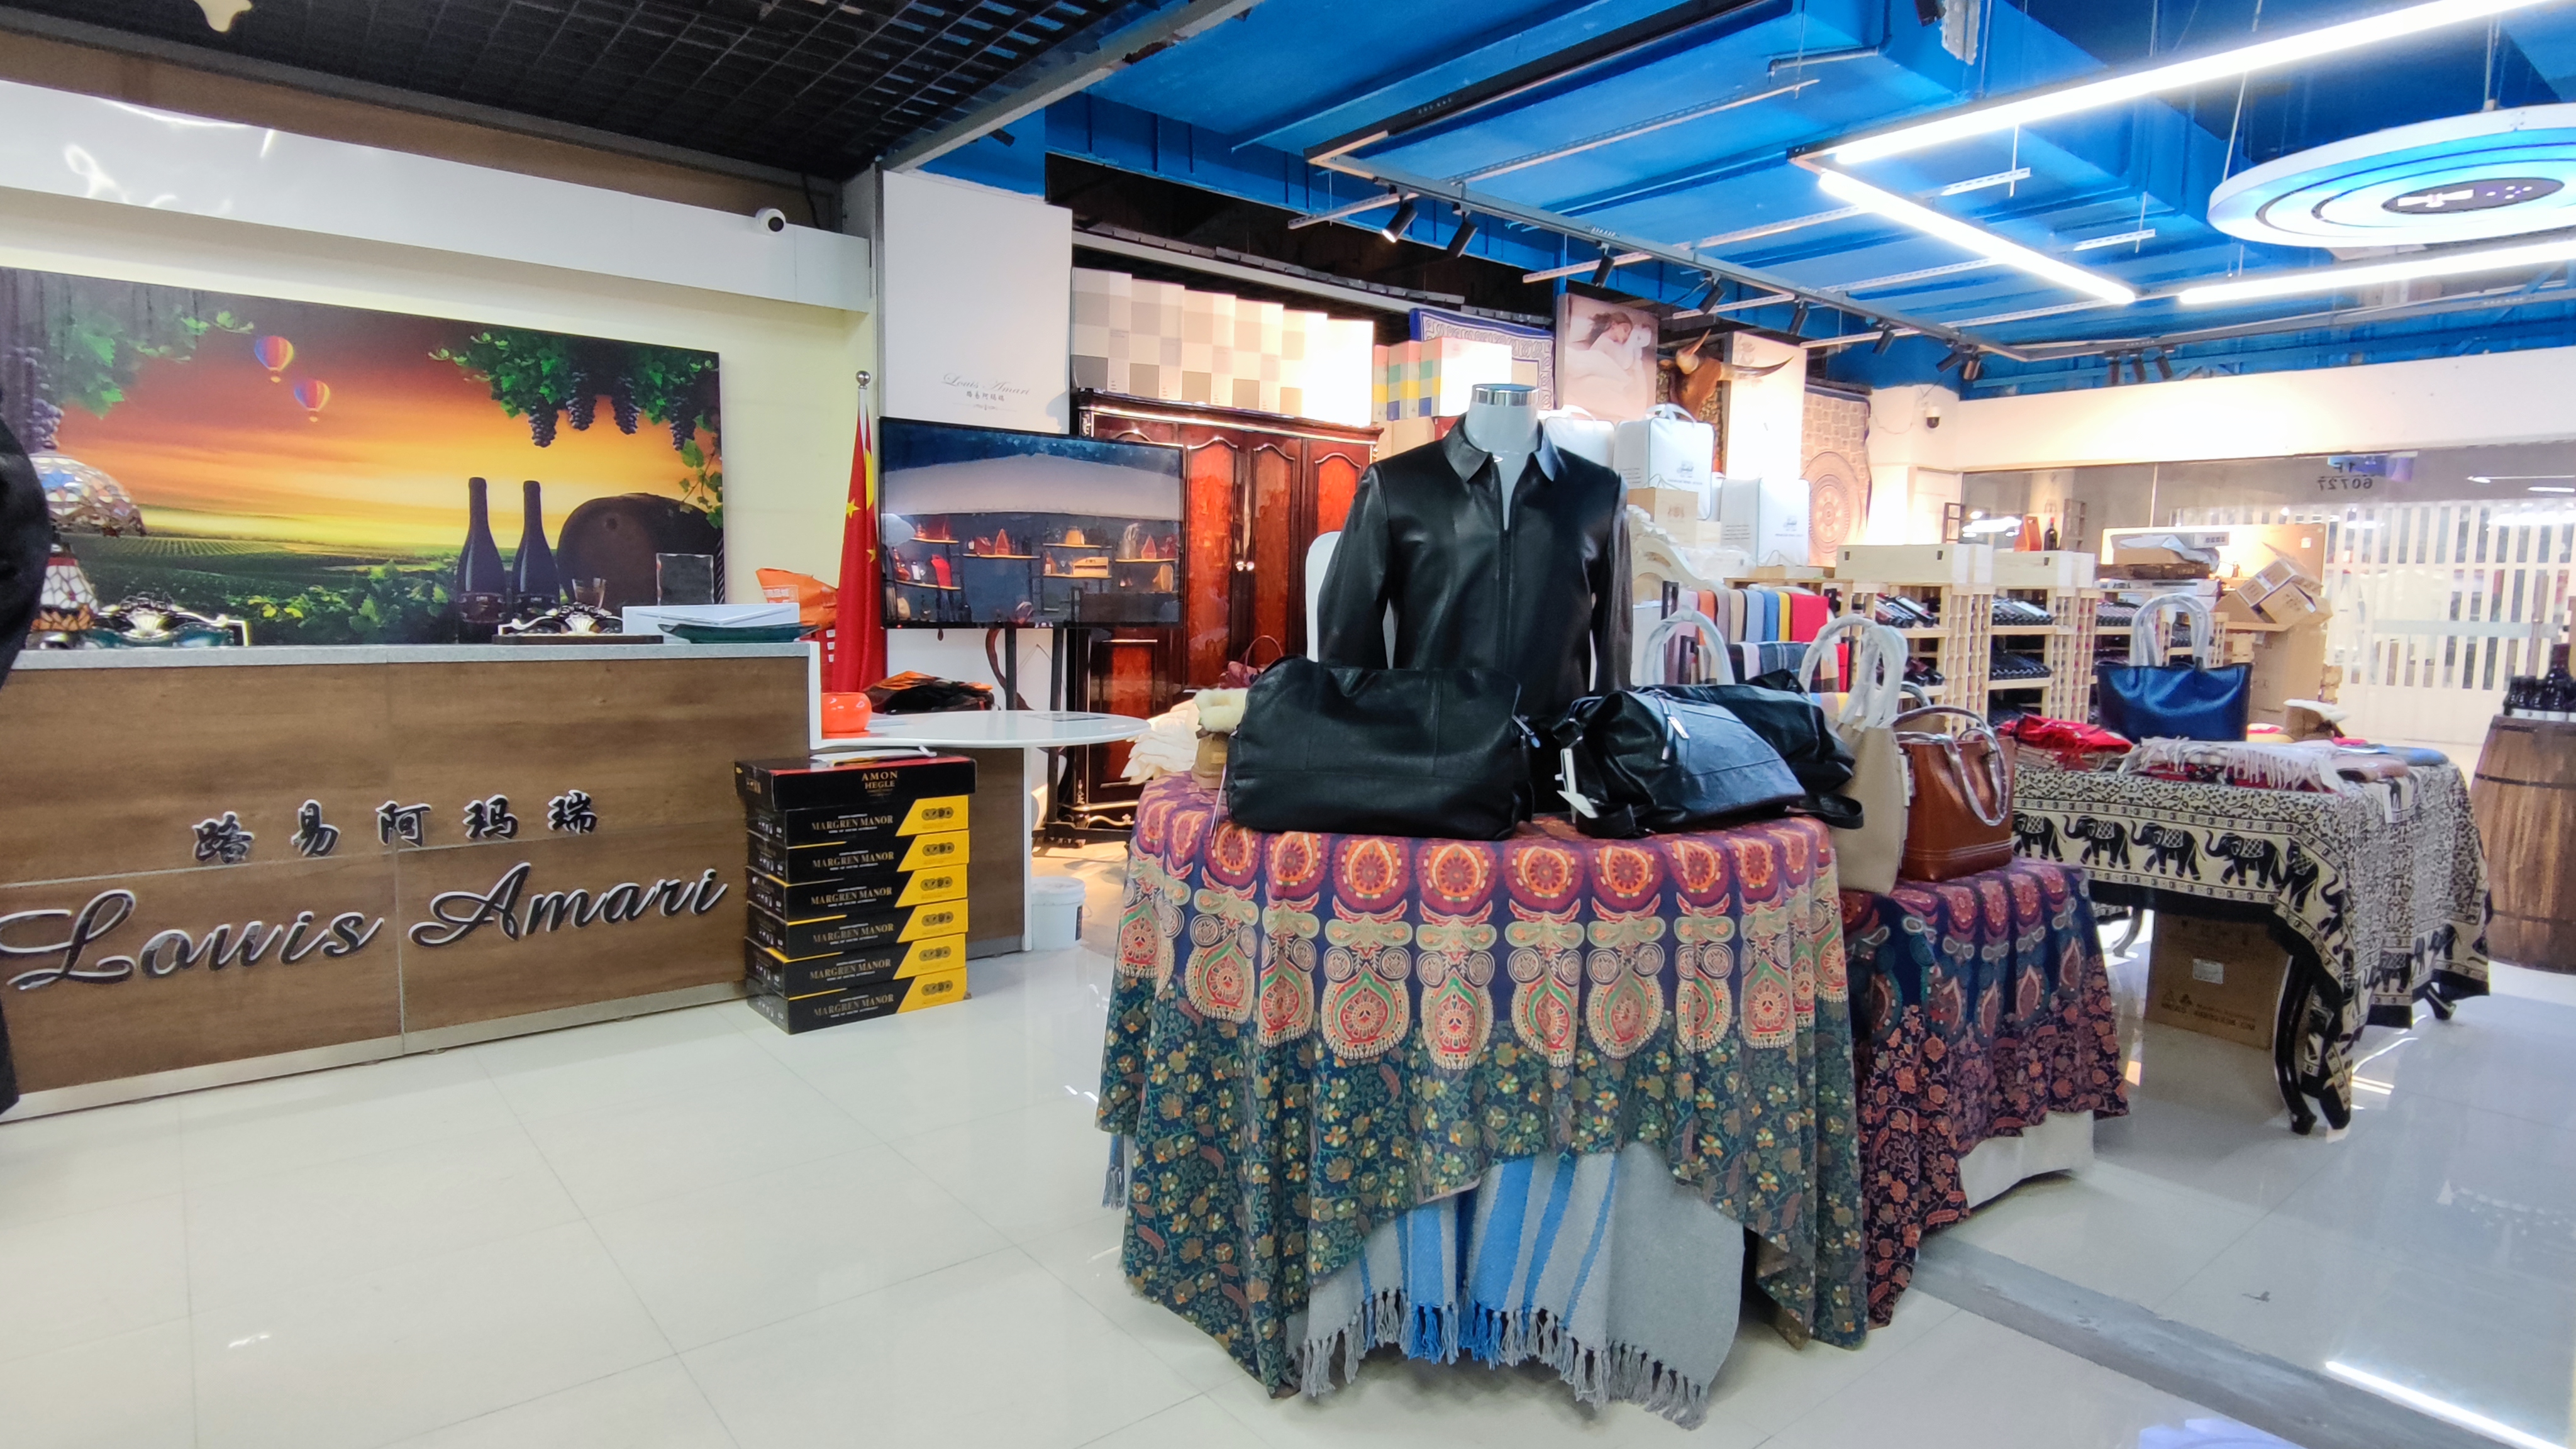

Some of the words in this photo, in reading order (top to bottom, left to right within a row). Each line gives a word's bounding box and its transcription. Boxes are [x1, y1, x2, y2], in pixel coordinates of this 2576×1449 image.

[862, 770, 897, 782] AMON
[865, 780, 895, 789] HEGLE
[191, 789, 599, 864] 路易阿玛瑞
[811, 818, 858, 831] MARGREN
[860, 815, 893, 827] MANOR
[813, 855, 859, 868] MARGREN
[861, 851, 894, 863] MANOR
[811, 891, 857, 905] MARGREN
[858, 887, 892, 898] MANOR
[0, 887, 385, 991] Louis
[408, 861, 728, 947] Amari
[813, 928, 859, 943] MARGREN
[860, 923, 894, 935] MANOR
[809, 965, 856, 979] MARGREN
[858, 958, 891, 971] MANOR
[813, 1001, 859, 1016] MARGREN
[861, 994, 894, 1006] MANOR
